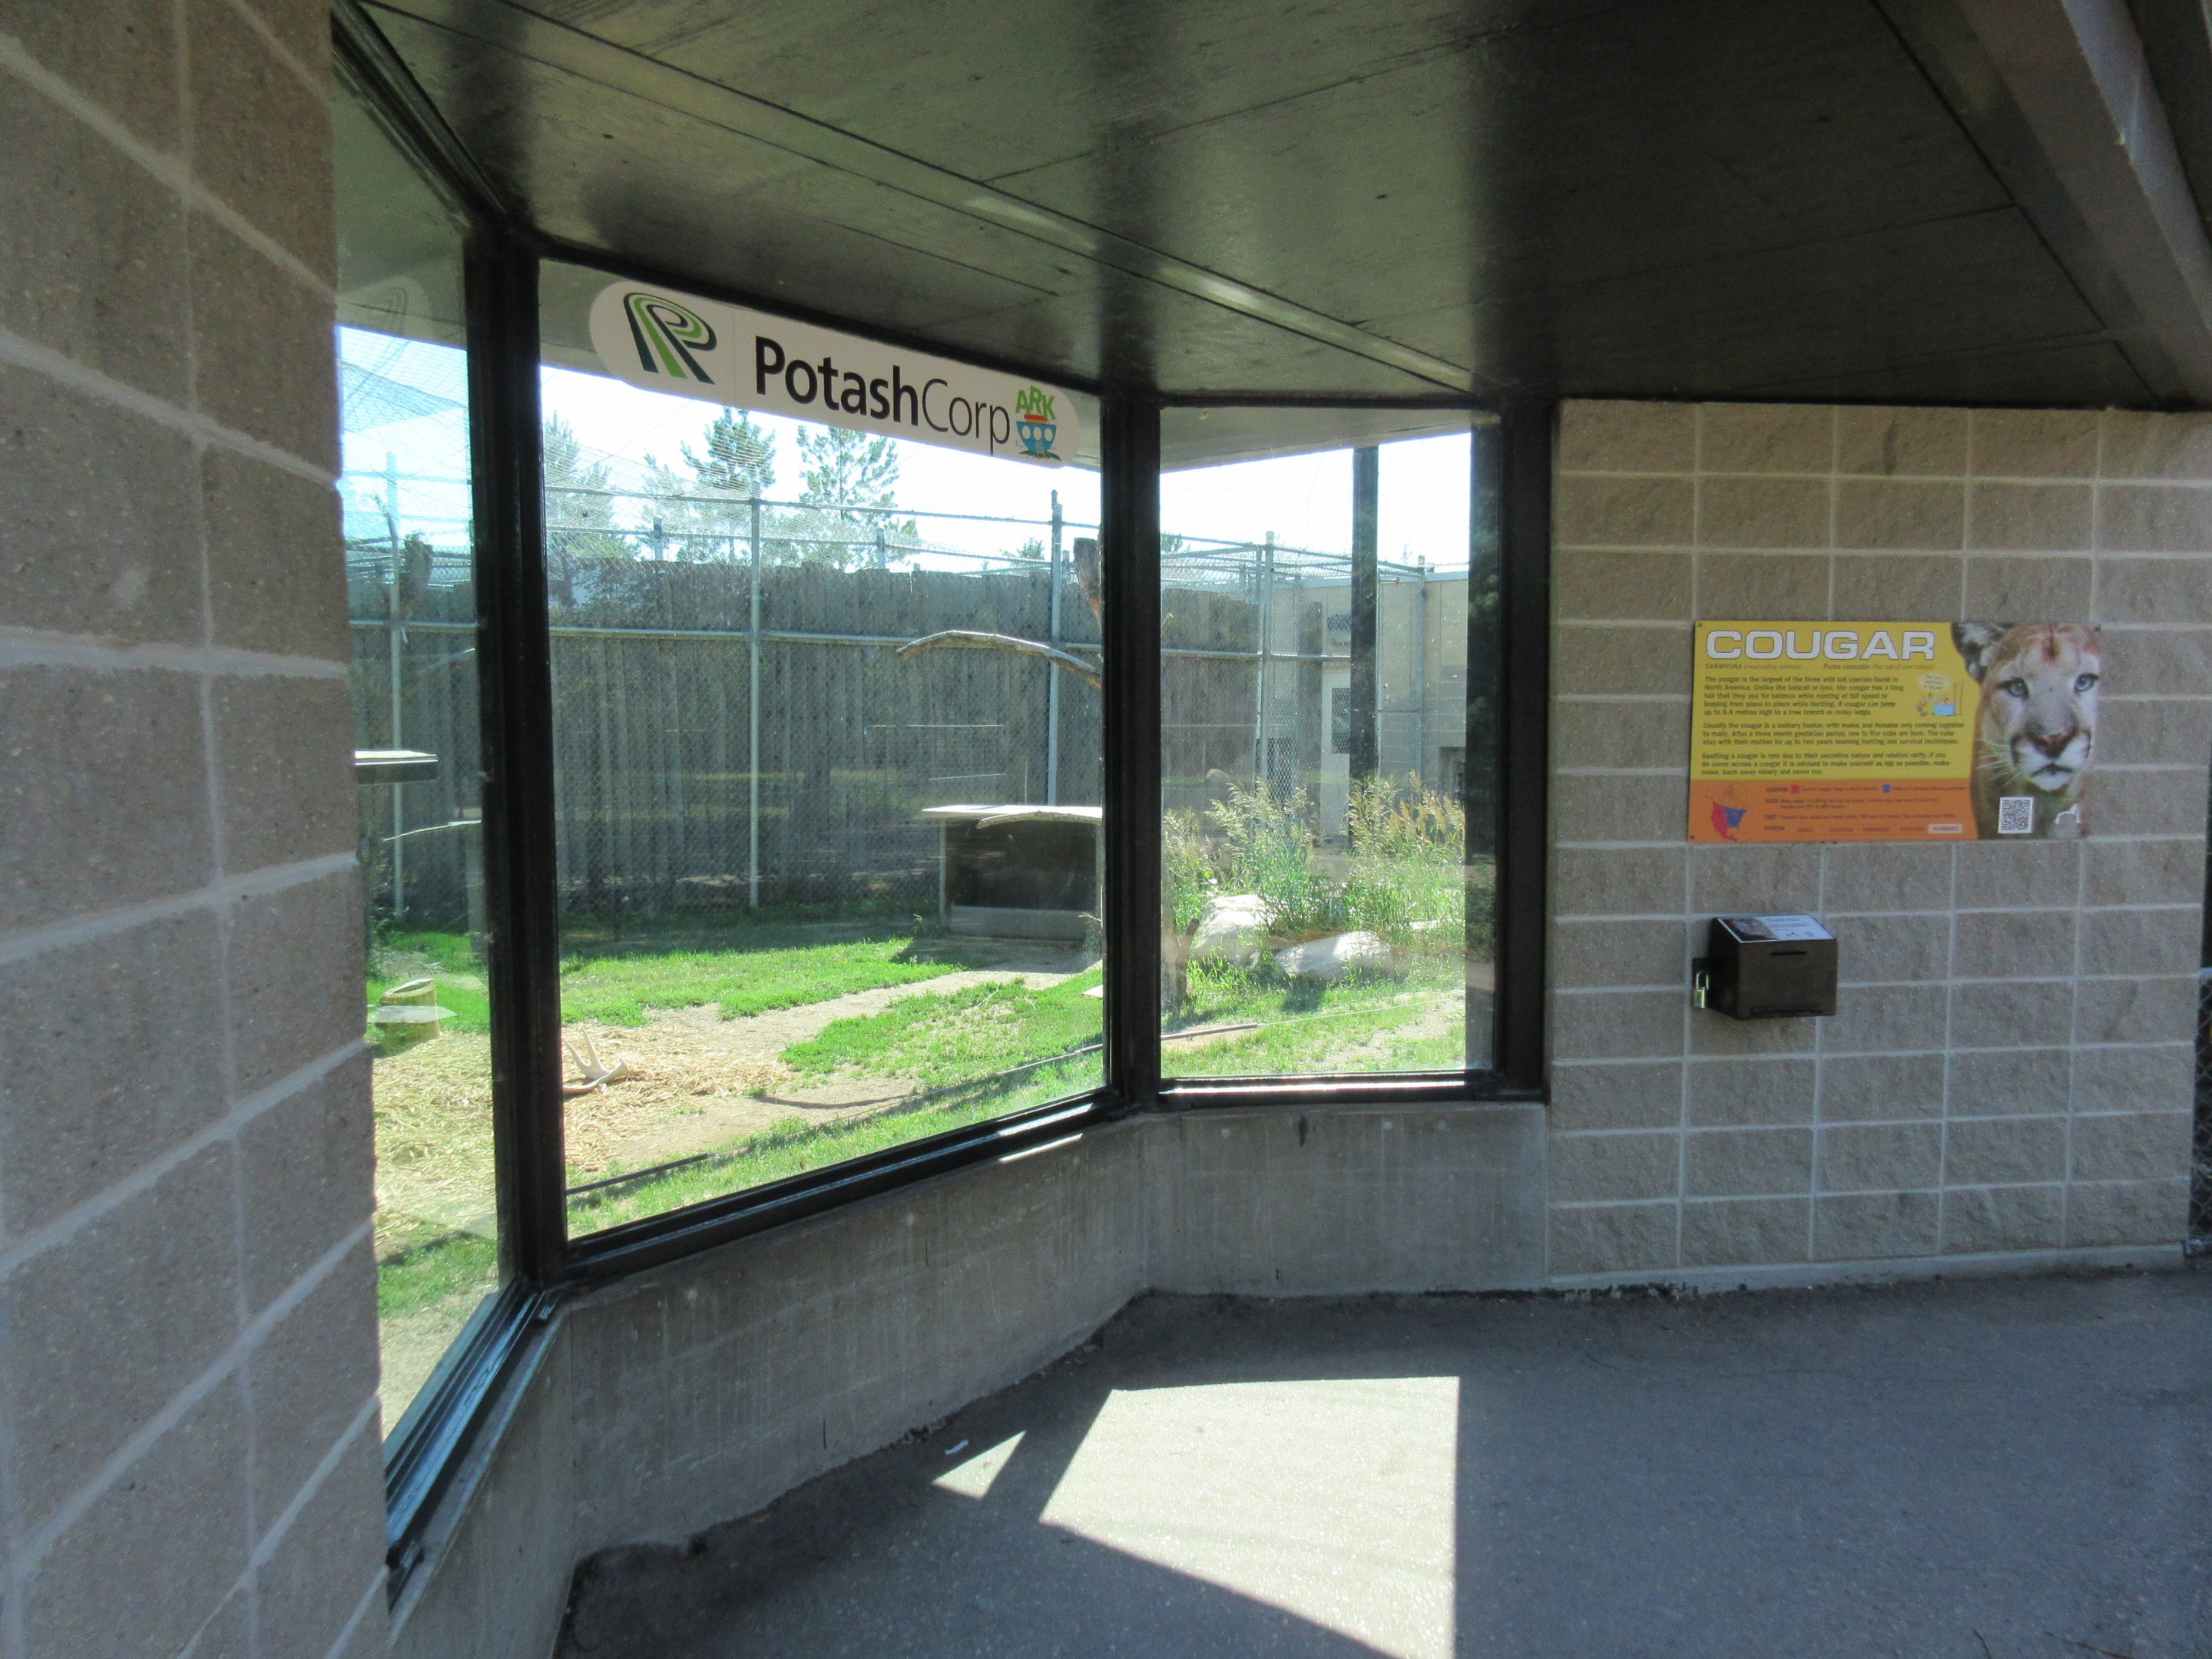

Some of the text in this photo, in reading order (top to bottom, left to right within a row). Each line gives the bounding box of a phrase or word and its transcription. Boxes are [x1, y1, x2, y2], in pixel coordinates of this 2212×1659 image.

[755, 336, 1011, 457] PotashCorp
[1015, 386, 1056, 420] ARK
[1706, 630, 1936, 660] COUGAR
